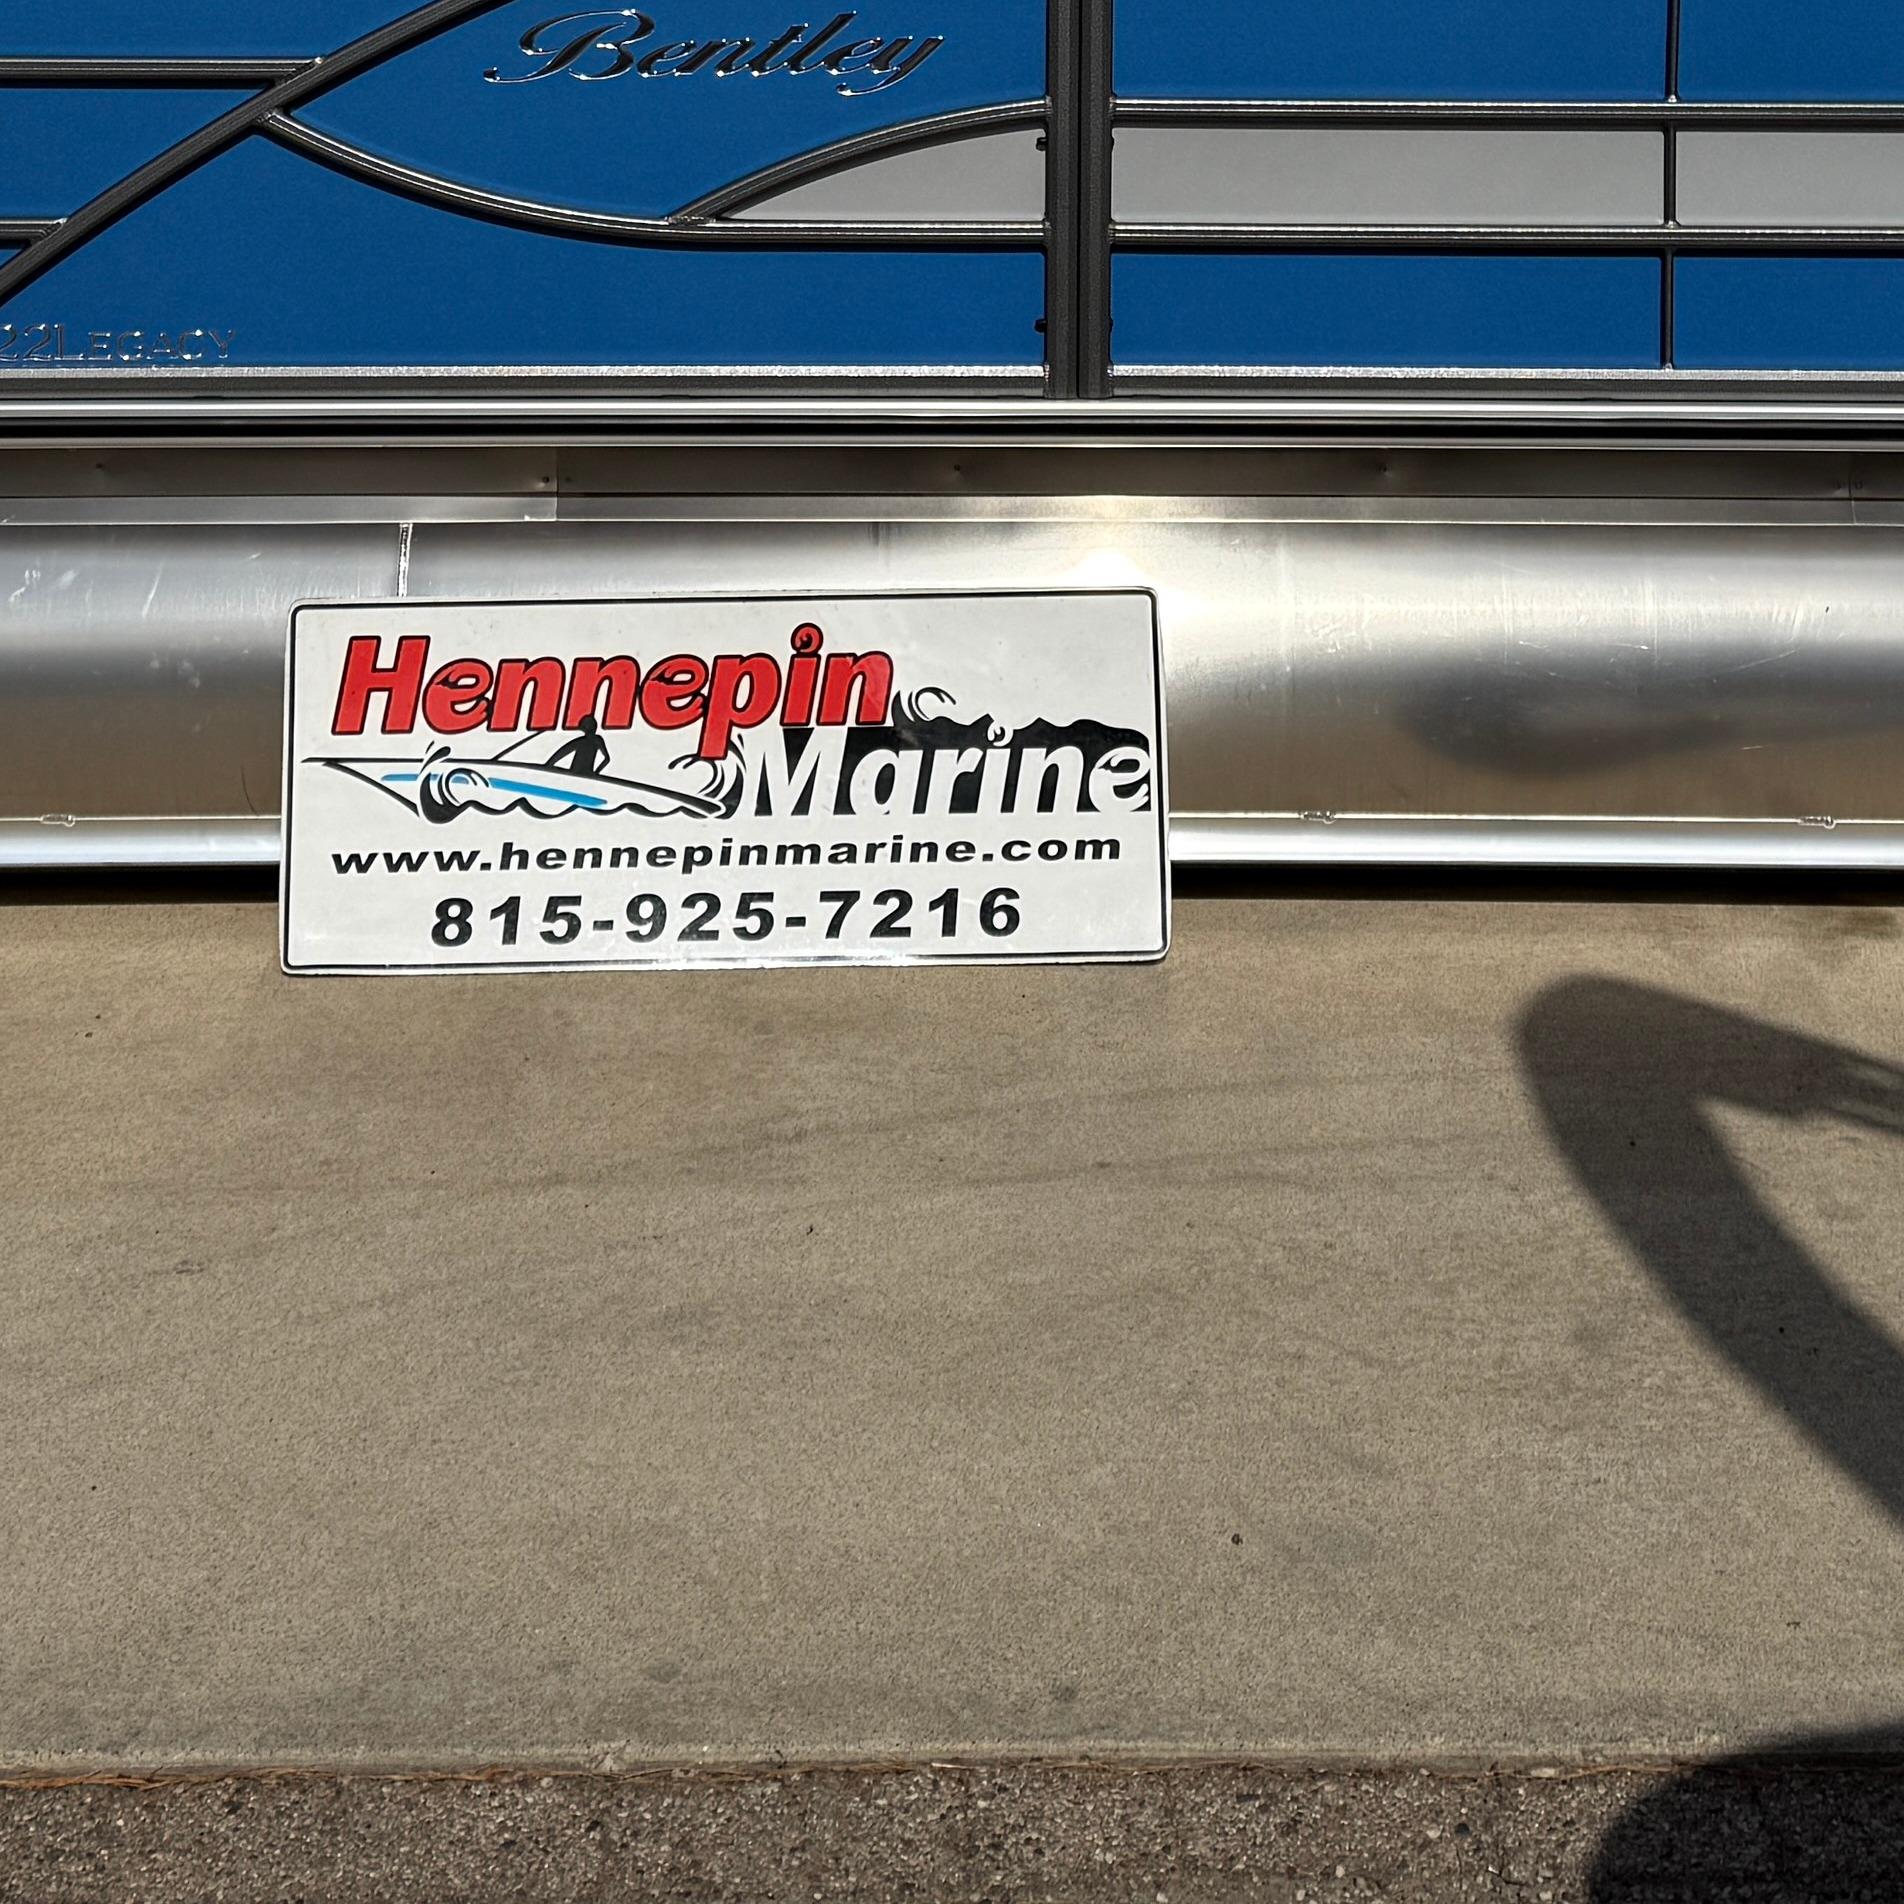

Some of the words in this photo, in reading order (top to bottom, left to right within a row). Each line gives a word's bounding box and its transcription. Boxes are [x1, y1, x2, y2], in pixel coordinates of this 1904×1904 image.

[483, 7, 945, 97] Bentley
[331, 622, 895, 760] Hennepin
[738, 725, 1152, 816] Marine
[331, 833, 1122, 874] www.hennepinmarine.com
[430, 887, 1022, 946] 815-925-7216
